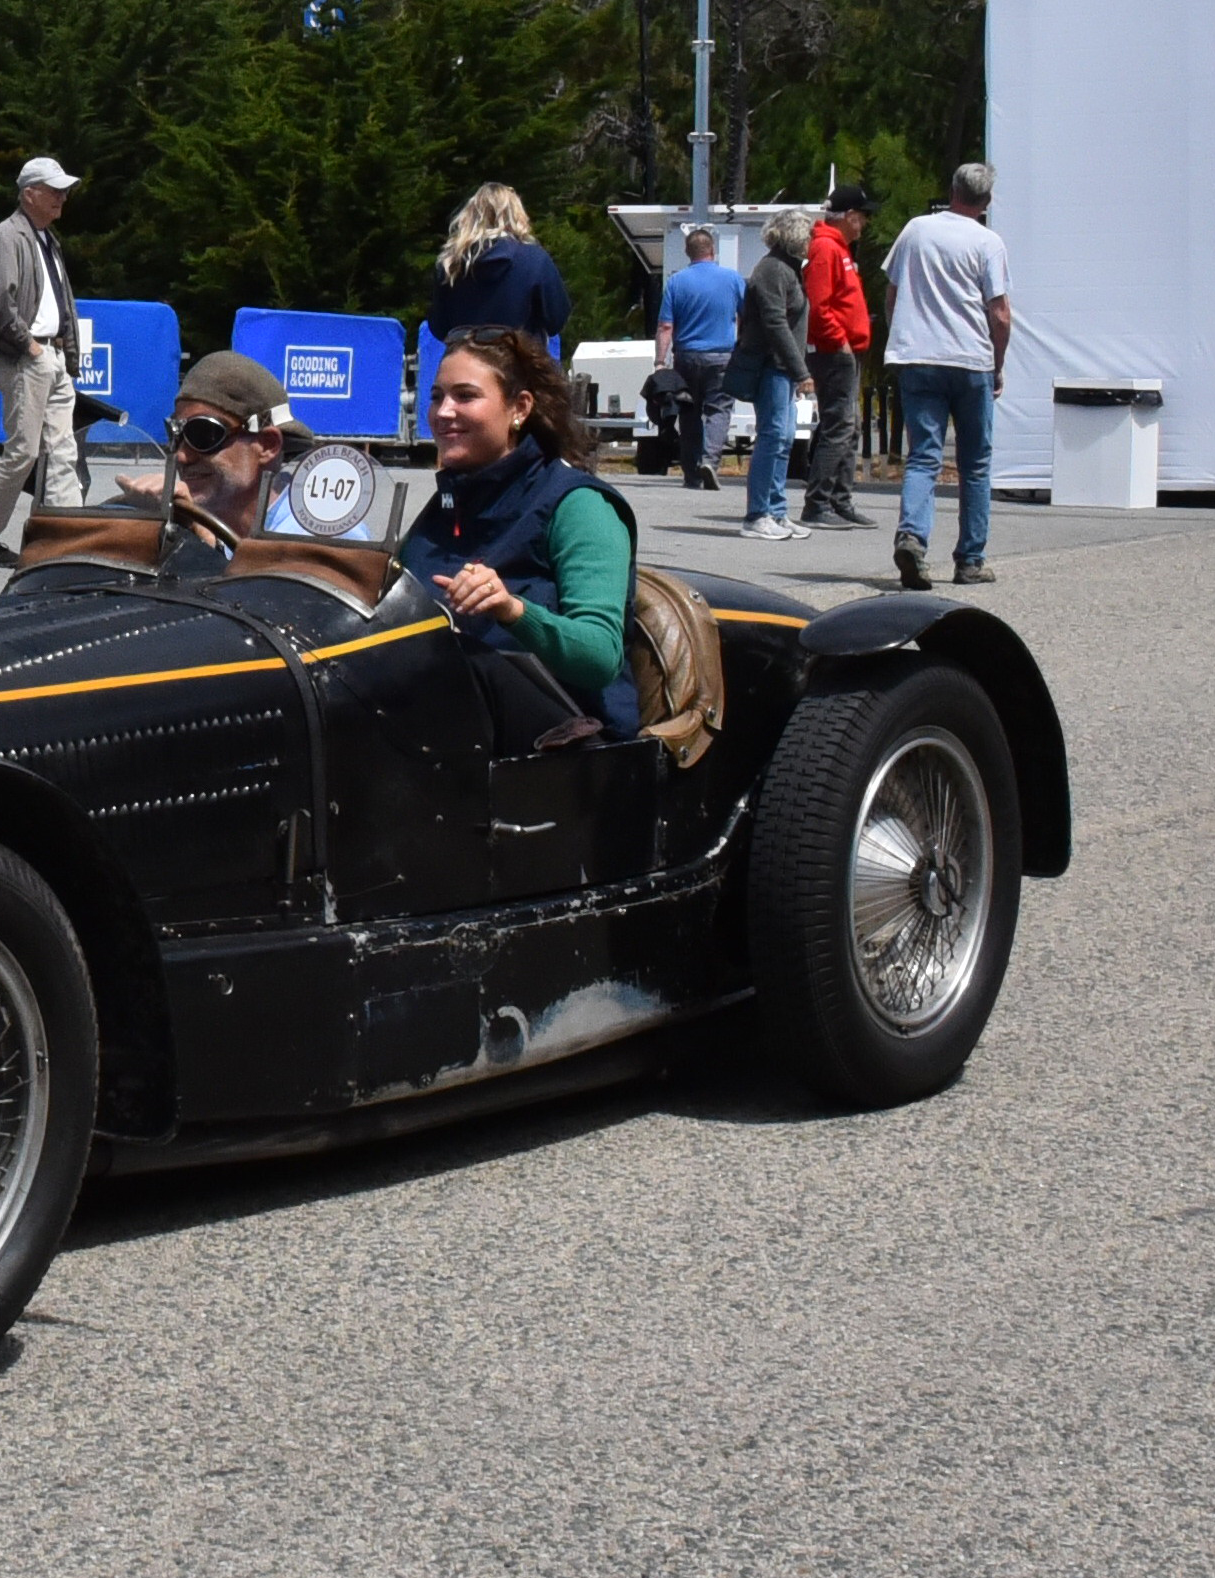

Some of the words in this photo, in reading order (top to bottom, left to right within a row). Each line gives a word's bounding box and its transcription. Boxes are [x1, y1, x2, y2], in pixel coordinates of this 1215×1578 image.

[291, 355, 338, 372] GOODING
[290, 372, 346, 388] &COMPANY
[303, 446, 339, 471] PEBBLE
[341, 447, 369, 477] BEACH
[310, 475, 355, 501] L1-07
